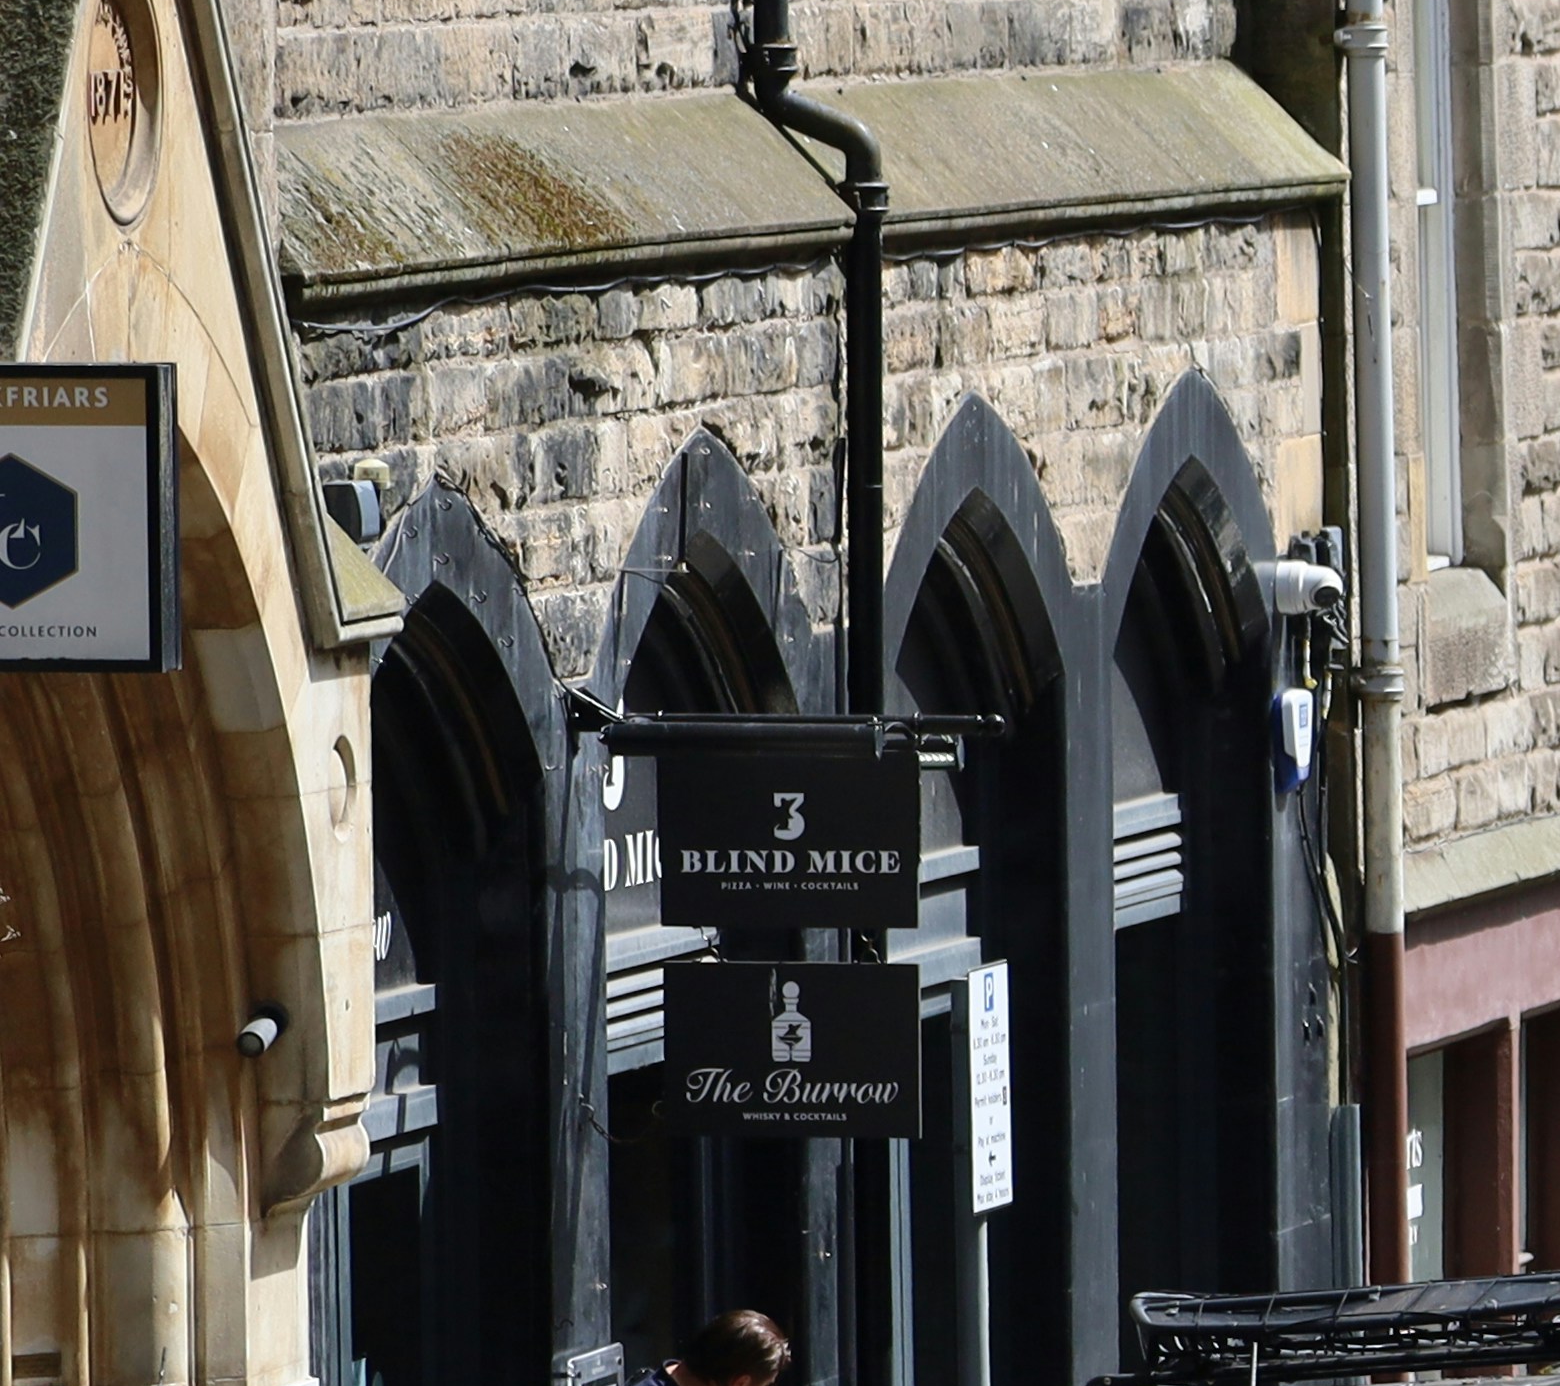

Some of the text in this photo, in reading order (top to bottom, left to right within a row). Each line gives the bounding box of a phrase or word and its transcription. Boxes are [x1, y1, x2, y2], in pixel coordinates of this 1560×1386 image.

[0, 386, 109, 409] FRIARS
[773, 792, 806, 841] 3
[680, 849, 901, 875] BLIND MICE
[720, 881, 860, 891] PIZZA WINE COCKTAILS
[685, 1067, 899, 1105] The Burrow
[743, 1111, 783, 1122] WHISKY
[793, 1111, 848, 1122] COCKTAILS
